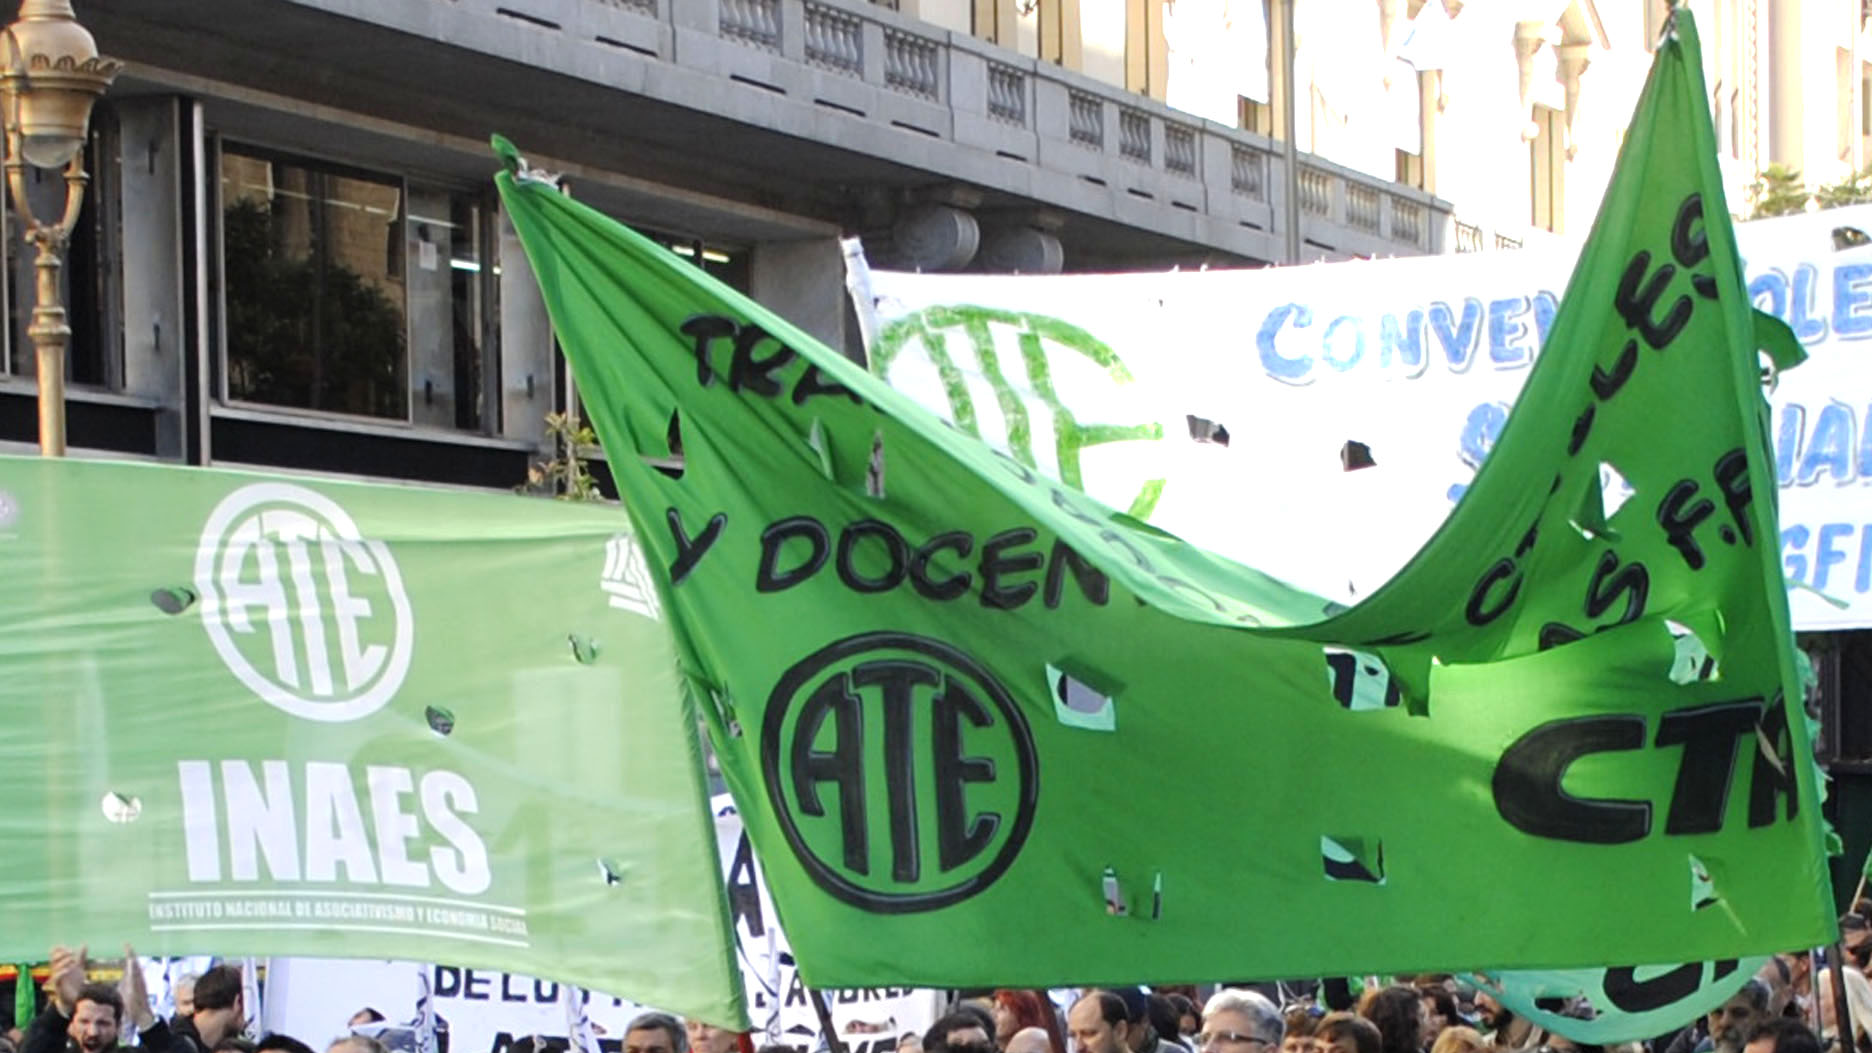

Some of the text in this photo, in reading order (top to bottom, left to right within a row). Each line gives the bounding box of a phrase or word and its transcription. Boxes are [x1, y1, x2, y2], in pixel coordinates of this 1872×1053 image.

[222, 513, 390, 697] ATE
[666, 506, 1146, 612] Y DOCEN
[177, 759, 492, 895] INAES
[791, 658, 1002, 884] ATE
[150, 901, 223, 920] INSTITUTO
[225, 901, 293, 918] NACIONAL
[291, 901, 313, 918] DE
